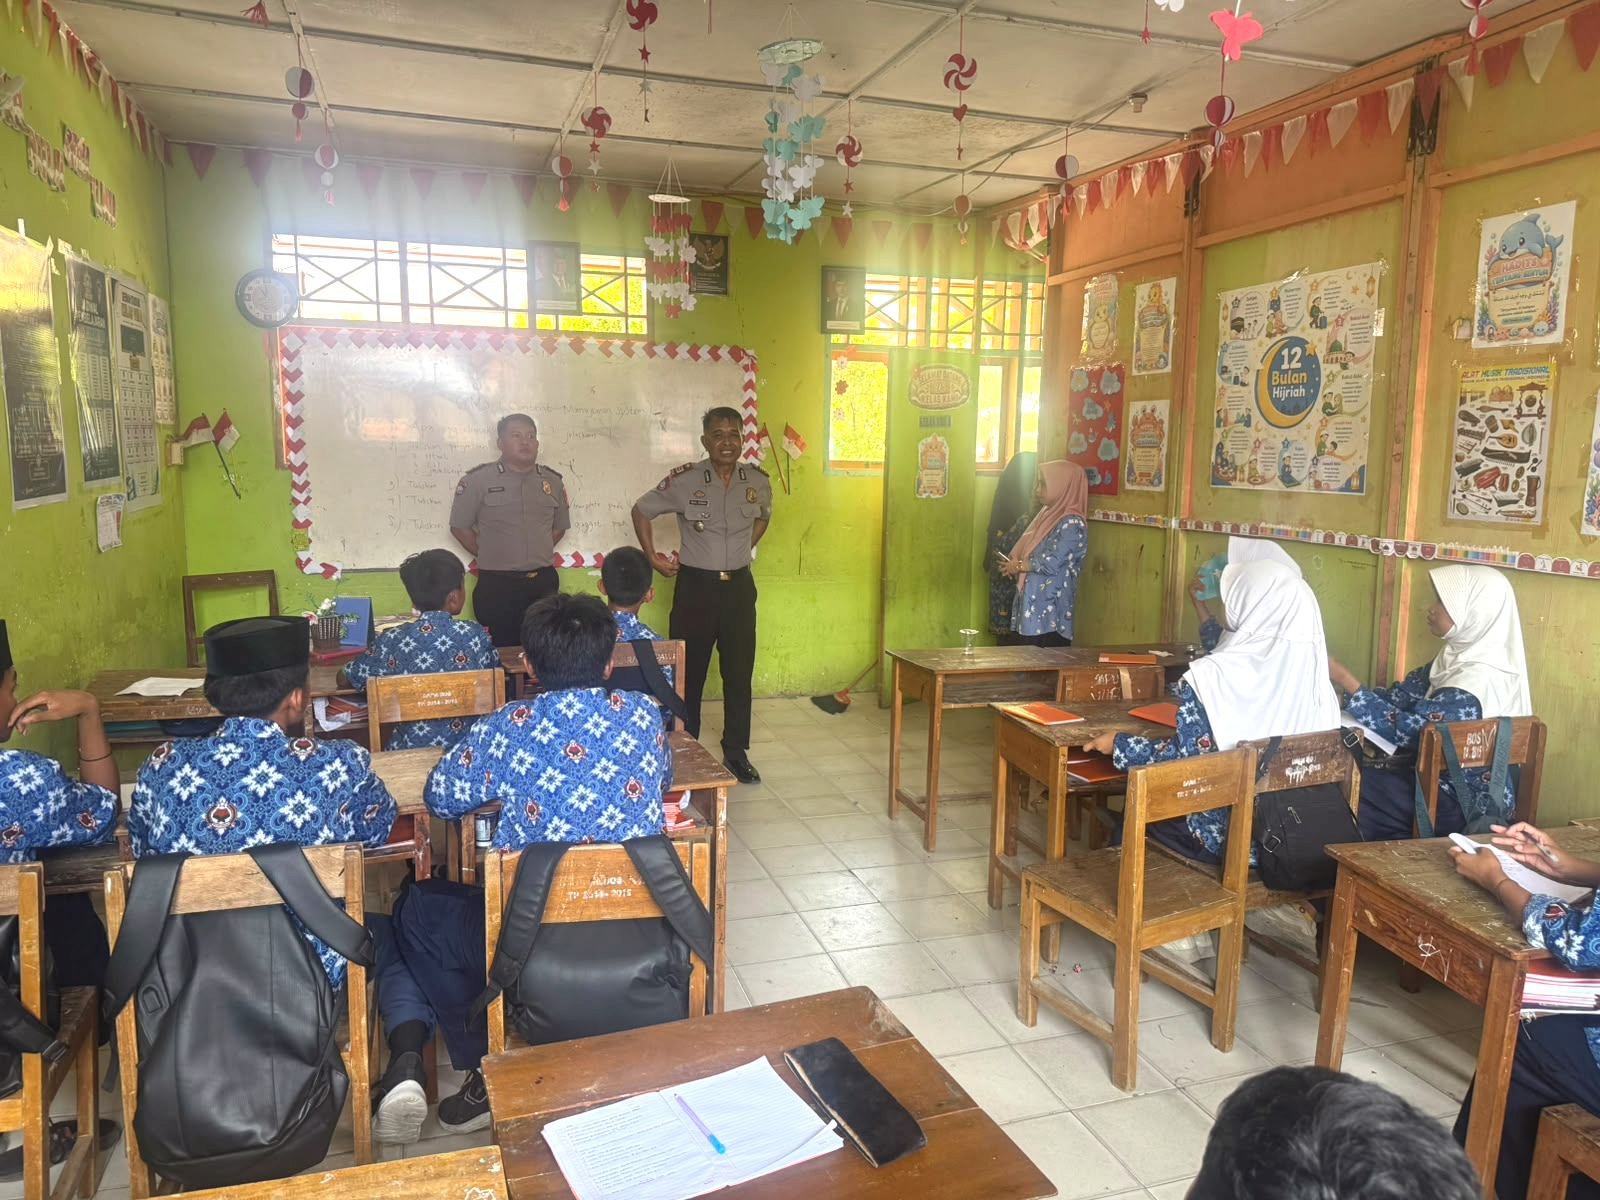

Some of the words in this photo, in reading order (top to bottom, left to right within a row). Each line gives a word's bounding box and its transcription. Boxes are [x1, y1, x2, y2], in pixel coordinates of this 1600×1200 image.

[1281, 346, 1302, 370] 12
[1272, 370, 1307, 386] Bulan
[1461, 371, 1480, 379] ALAT
[1481, 369, 1502, 378] MUSIK
[1504, 366, 1550, 376] TRADISIONAL
[1272, 385, 1306, 401] Hijriah
[1466, 732, 1482, 746] BOS
